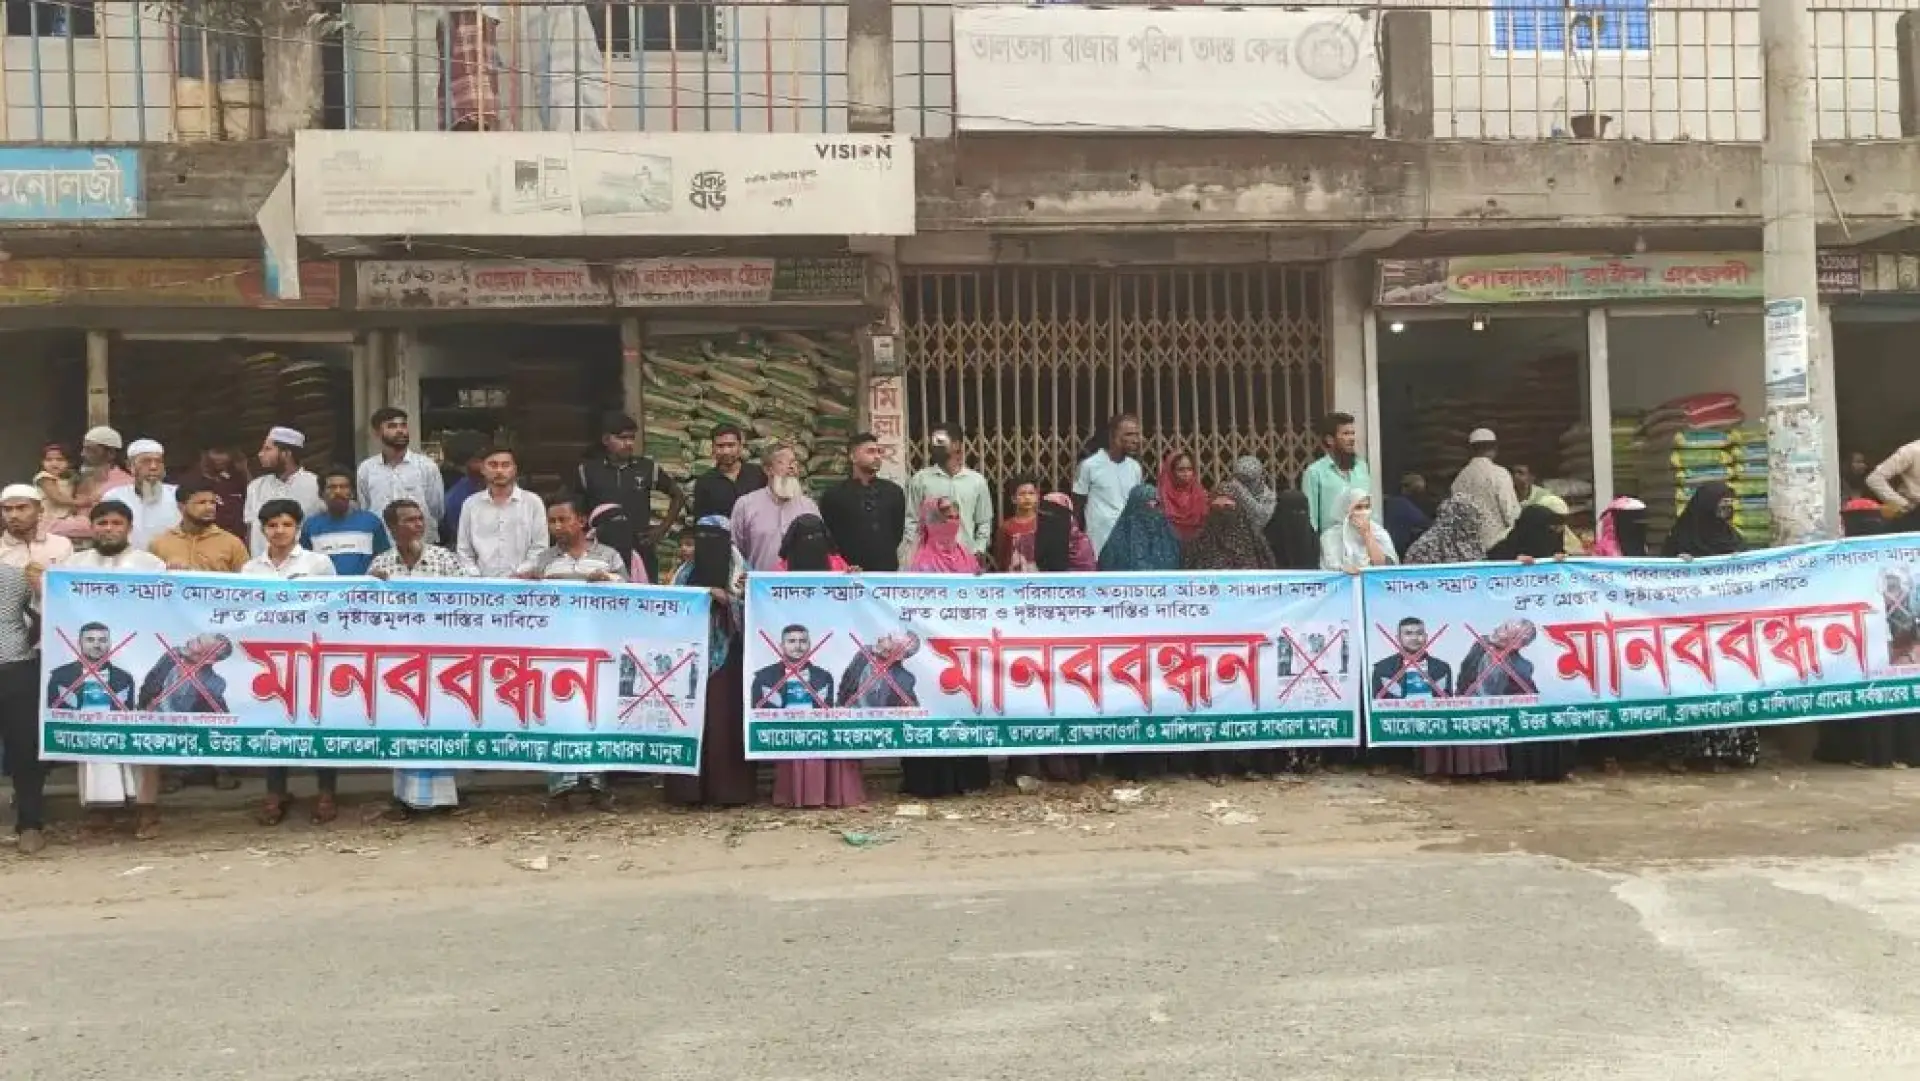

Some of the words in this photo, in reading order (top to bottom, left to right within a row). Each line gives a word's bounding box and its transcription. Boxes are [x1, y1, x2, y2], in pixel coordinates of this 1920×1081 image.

[970, 33, 1054, 63] তালতলা
[1058, 34, 1118, 63] বাজার
[1127, 26, 1185, 72] পুলিশ
[1189, 36, 1236, 63] তদন্ত
[1245, 37, 1291, 66] কেন্দ্র
[1384, 579, 1428, 593] মাদক
[1437, 575, 1476, 593] সম্রাট
[1486, 572, 1561, 591] মোতালেব
[1570, 573, 1579, 583] ও
[1589, 570, 1613, 583] তার
[1826, 549, 1879, 568] সাধারণ
[71, 581, 118, 598] মাদক
[129, 581, 174, 600] সম্রাট
[182, 585, 265, 602] মোতালেব
[275, 590, 288, 602] ও
[298, 588, 327, 603] তার
[338, 586, 418, 605] পরিবারের
[428, 591, 504, 608] অত্যাচারে
[569, 593, 629, 610] সাধারণ
[771, 586, 815, 599] মাদক
[822, 582, 864, 600] সম্রাট
[872, 585, 948, 600] মোতালেব
[958, 588, 967, 600] ও
[976, 586, 1004, 600] তার
[1014, 581, 1085, 600] পরিবারের
[1095, 583, 1166, 599] অত্যাচারে
[1228, 583, 1282, 598] সাধারণ
[1515, 595, 1547, 610] দ্রুত
[1606, 590, 1617, 602] ও
[1760, 575, 1809, 592] দাবিতে
[210, 608, 245, 625] দ্রুত
[317, 611, 328, 624] ও
[434, 610, 482, 627] শাস্তির
[491, 610, 549, 628] দাবিতে
[900, 606, 932, 622] দ্রুত
[997, 608, 1007, 619] ও
[1103, 603, 1148, 619] শাস্তির
[1156, 602, 1210, 618] দাবিতে
[1542, 602, 1878, 697] মানববন্ধন
[239, 632, 616, 728] মানববন্ধন
[927, 627, 1273, 715] মানববন্ধন
[1518, 709, 1548, 729] উত্তর
[1748, 698, 1757, 714] ও
[1816, 689, 1852, 710] গ্রামের
[209, 729, 241, 752] উত্তর
[323, 735, 384, 759] তালতলা,
[476, 740, 487, 755] ও
[552, 739, 593, 760] গ্রামের
[598, 740, 643, 761] সাধারণ
[902, 723, 932, 744] উত্তর
[1009, 724, 1063, 745] তালতলা,
[1145, 724, 1156, 738] ও
[1219, 721, 1257, 737] গ্রামের
[1261, 720, 1301, 737] সাধারণ
